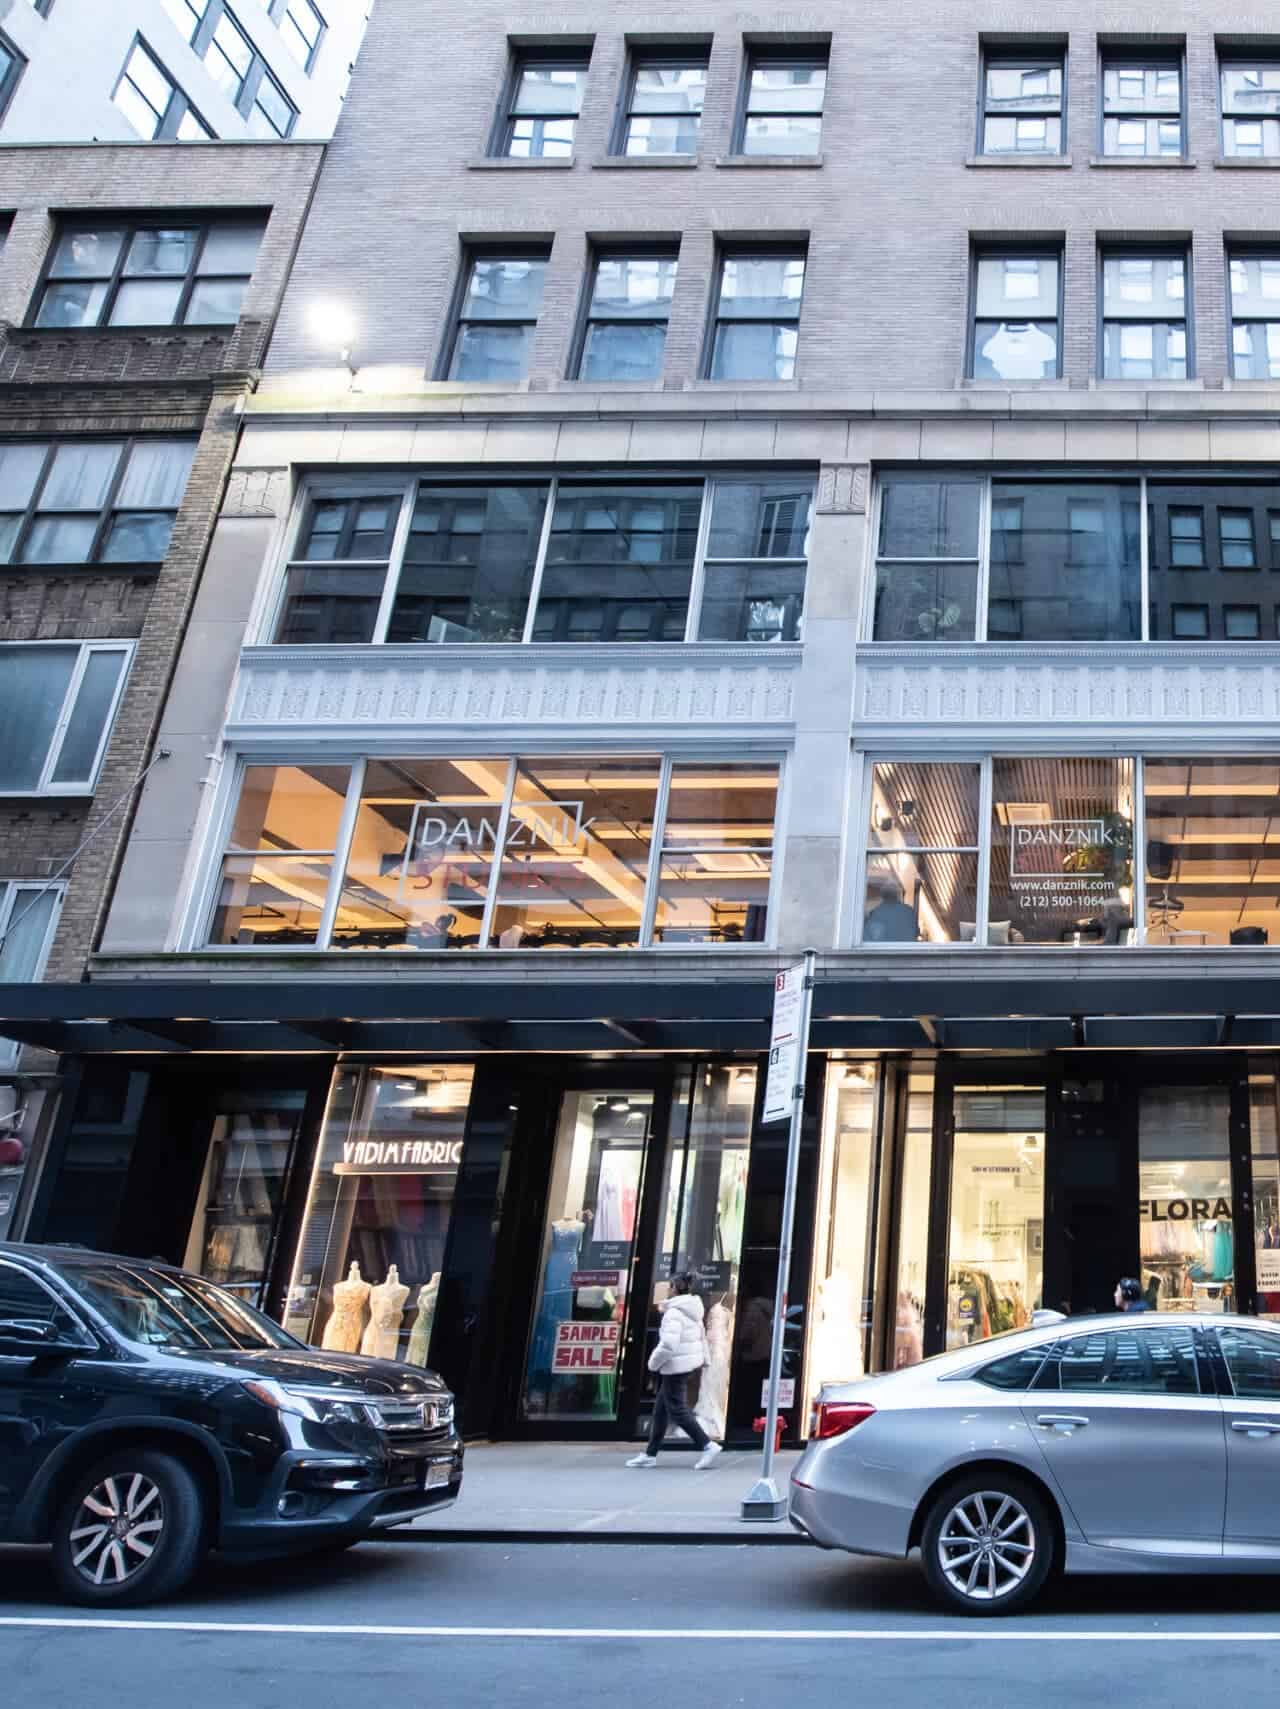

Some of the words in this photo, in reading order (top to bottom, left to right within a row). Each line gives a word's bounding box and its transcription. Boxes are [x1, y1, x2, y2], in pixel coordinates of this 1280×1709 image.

[421, 817, 597, 847] DANZNIK
[1018, 828, 1115, 845] DANZNIK
[1010, 880, 1115, 891] www.danznik.com
[1019, 895, 1049, 908] (212)
[1052, 895, 1105, 907] 500-1064
[559, 1325, 617, 1341] SAMPLE
[554, 1346, 616, 1367] SALE
